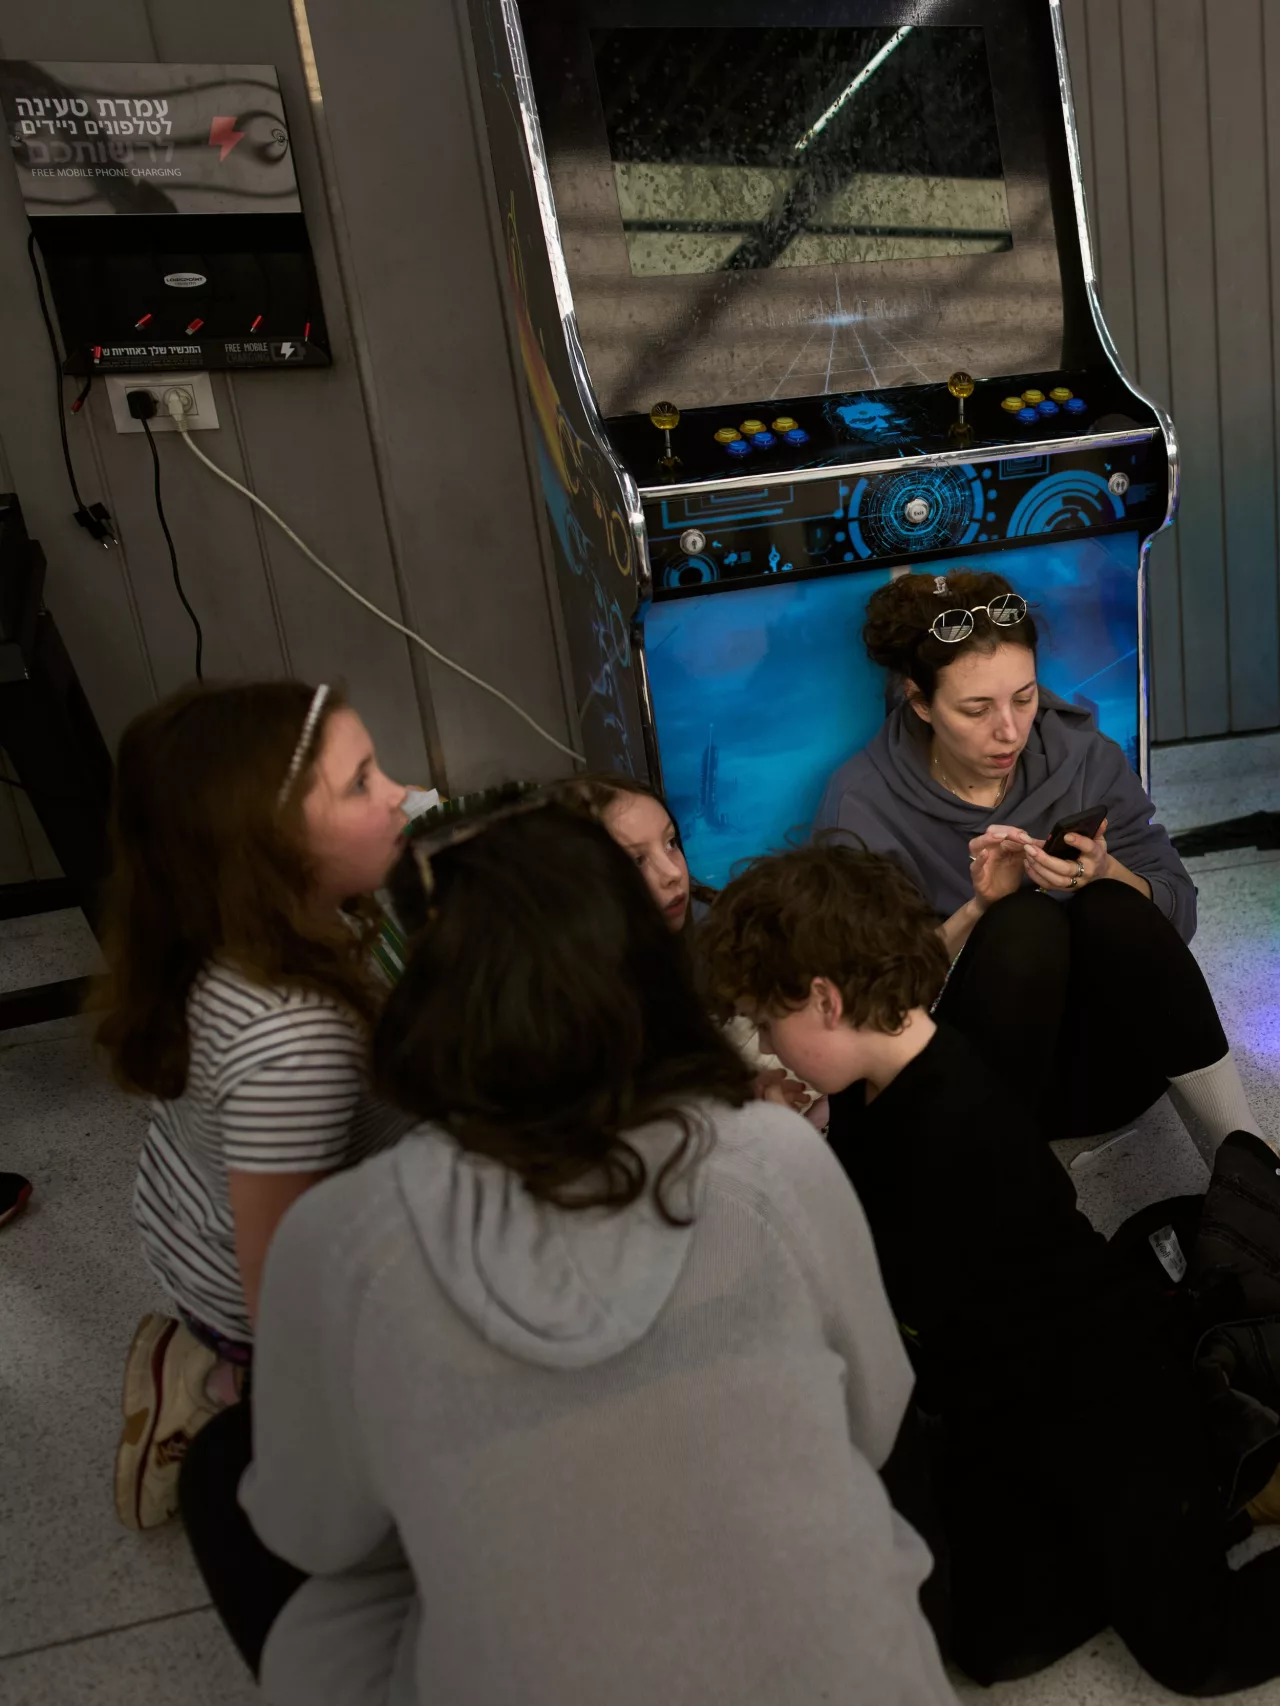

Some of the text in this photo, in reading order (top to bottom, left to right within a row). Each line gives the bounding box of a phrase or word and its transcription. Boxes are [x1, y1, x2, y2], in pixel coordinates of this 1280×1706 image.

[15, 97, 169, 118] עמדת טעינה
[20, 117, 173, 135] לטלפונים ניידים
[31, 168, 182, 177] FREE MOBILE PHONE CHARGING
[148, 345, 167, 356] שלך
[167, 345, 202, 354] המכשיר
[224, 342, 268, 353] FREE MOBILE
